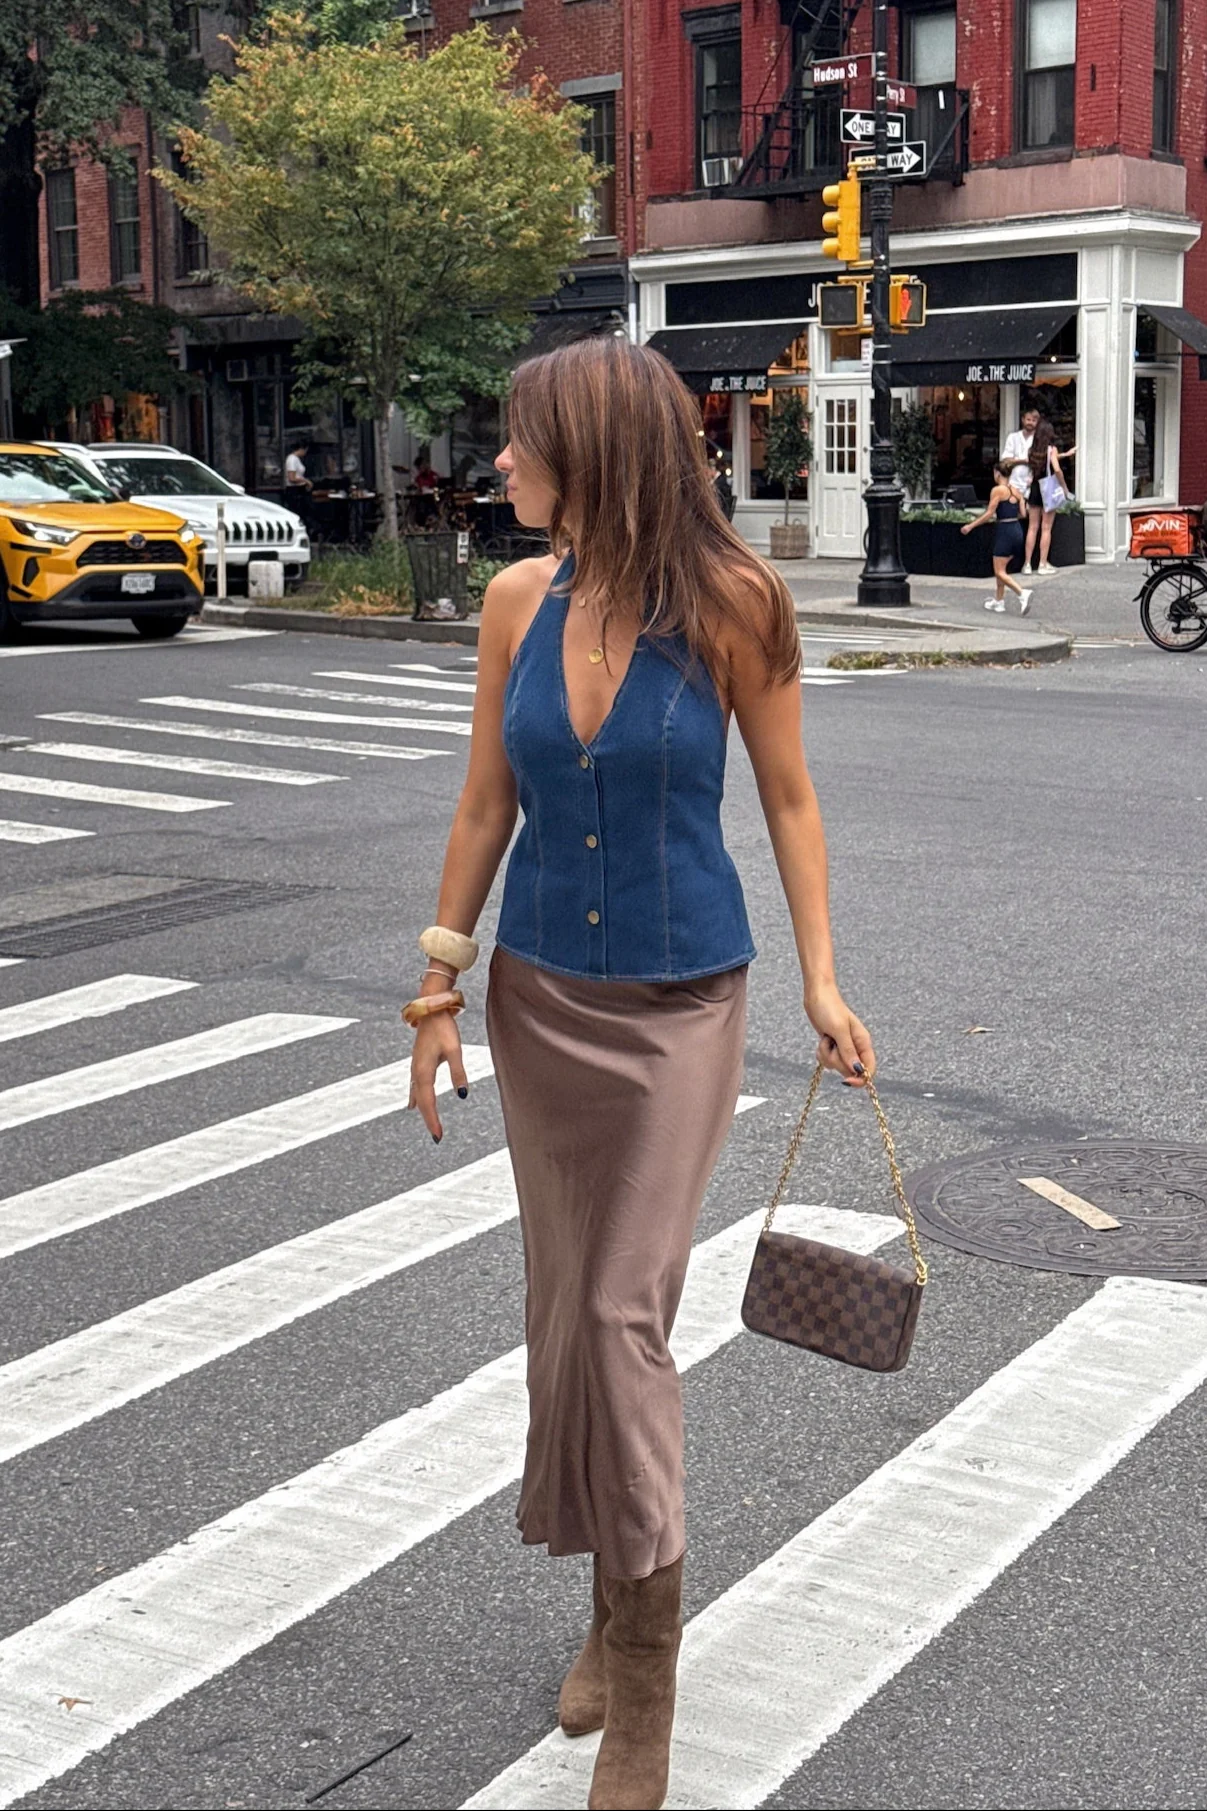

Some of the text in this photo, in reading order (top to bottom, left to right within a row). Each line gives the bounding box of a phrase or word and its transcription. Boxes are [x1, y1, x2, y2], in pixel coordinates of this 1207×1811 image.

[813, 62, 858, 82] Hudson St
[851, 120, 870, 133] ONE
[891, 153, 913, 166] WAY
[966, 366, 982, 382] JOE
[989, 365, 1005, 381] THE
[1007, 364, 1033, 380] JUICE
